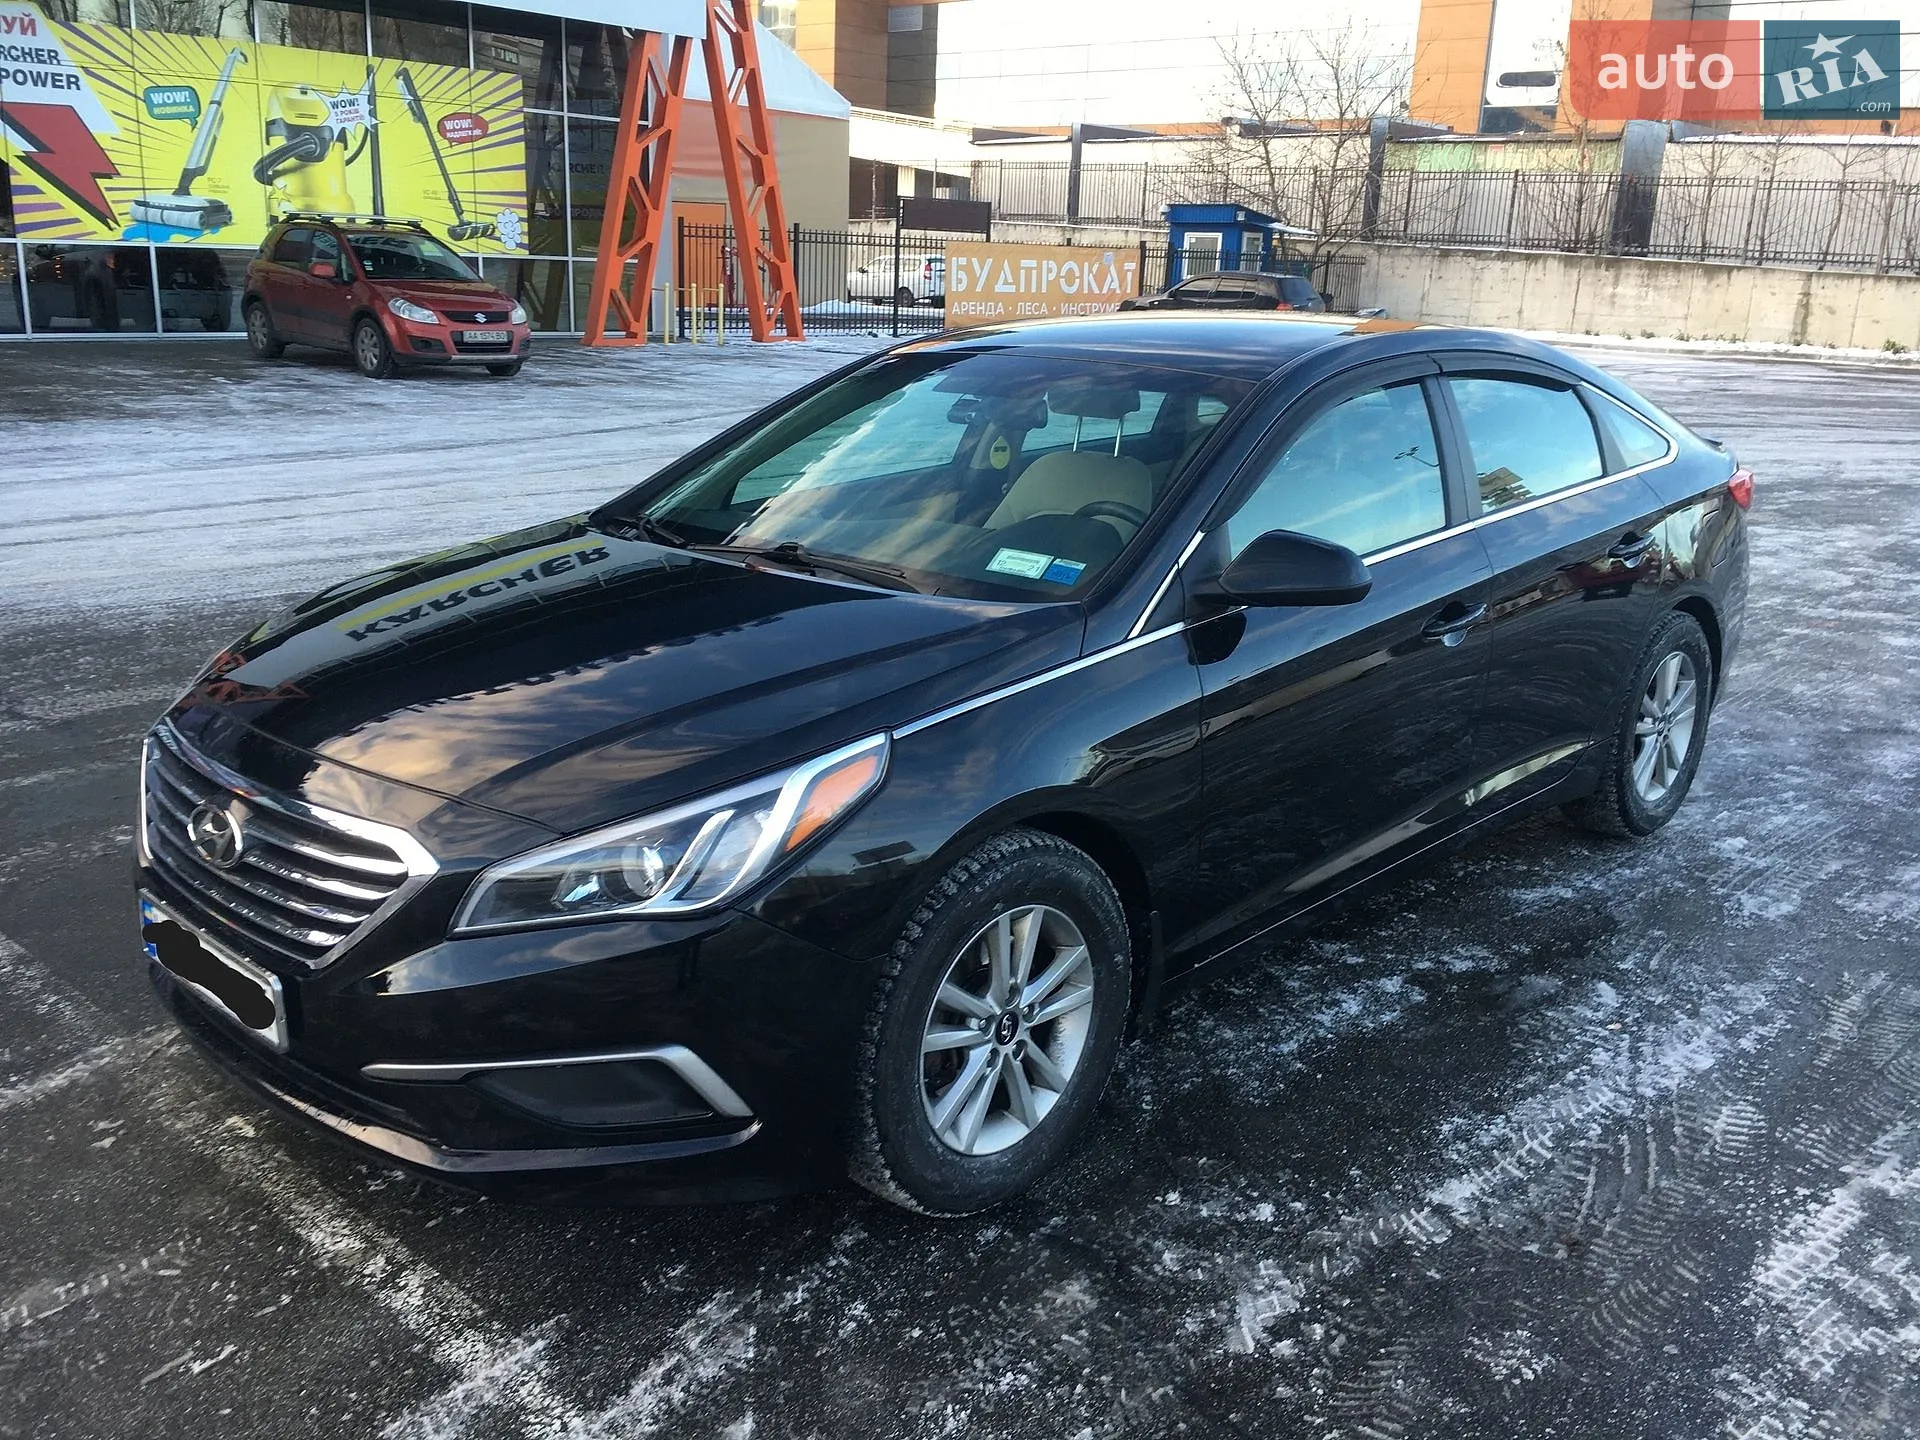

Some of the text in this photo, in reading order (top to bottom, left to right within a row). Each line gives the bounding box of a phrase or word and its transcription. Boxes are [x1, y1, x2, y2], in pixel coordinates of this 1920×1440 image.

[150, 91, 190, 104] WOW!
[329, 98, 360, 109] WOW!
[444, 119, 472, 130] WOW!
[951, 256, 1137, 294] БУДПРОКАТ
[952, 302, 1004, 316] АРЕНДА
[1016, 302, 1049, 315] ЛЕСА
